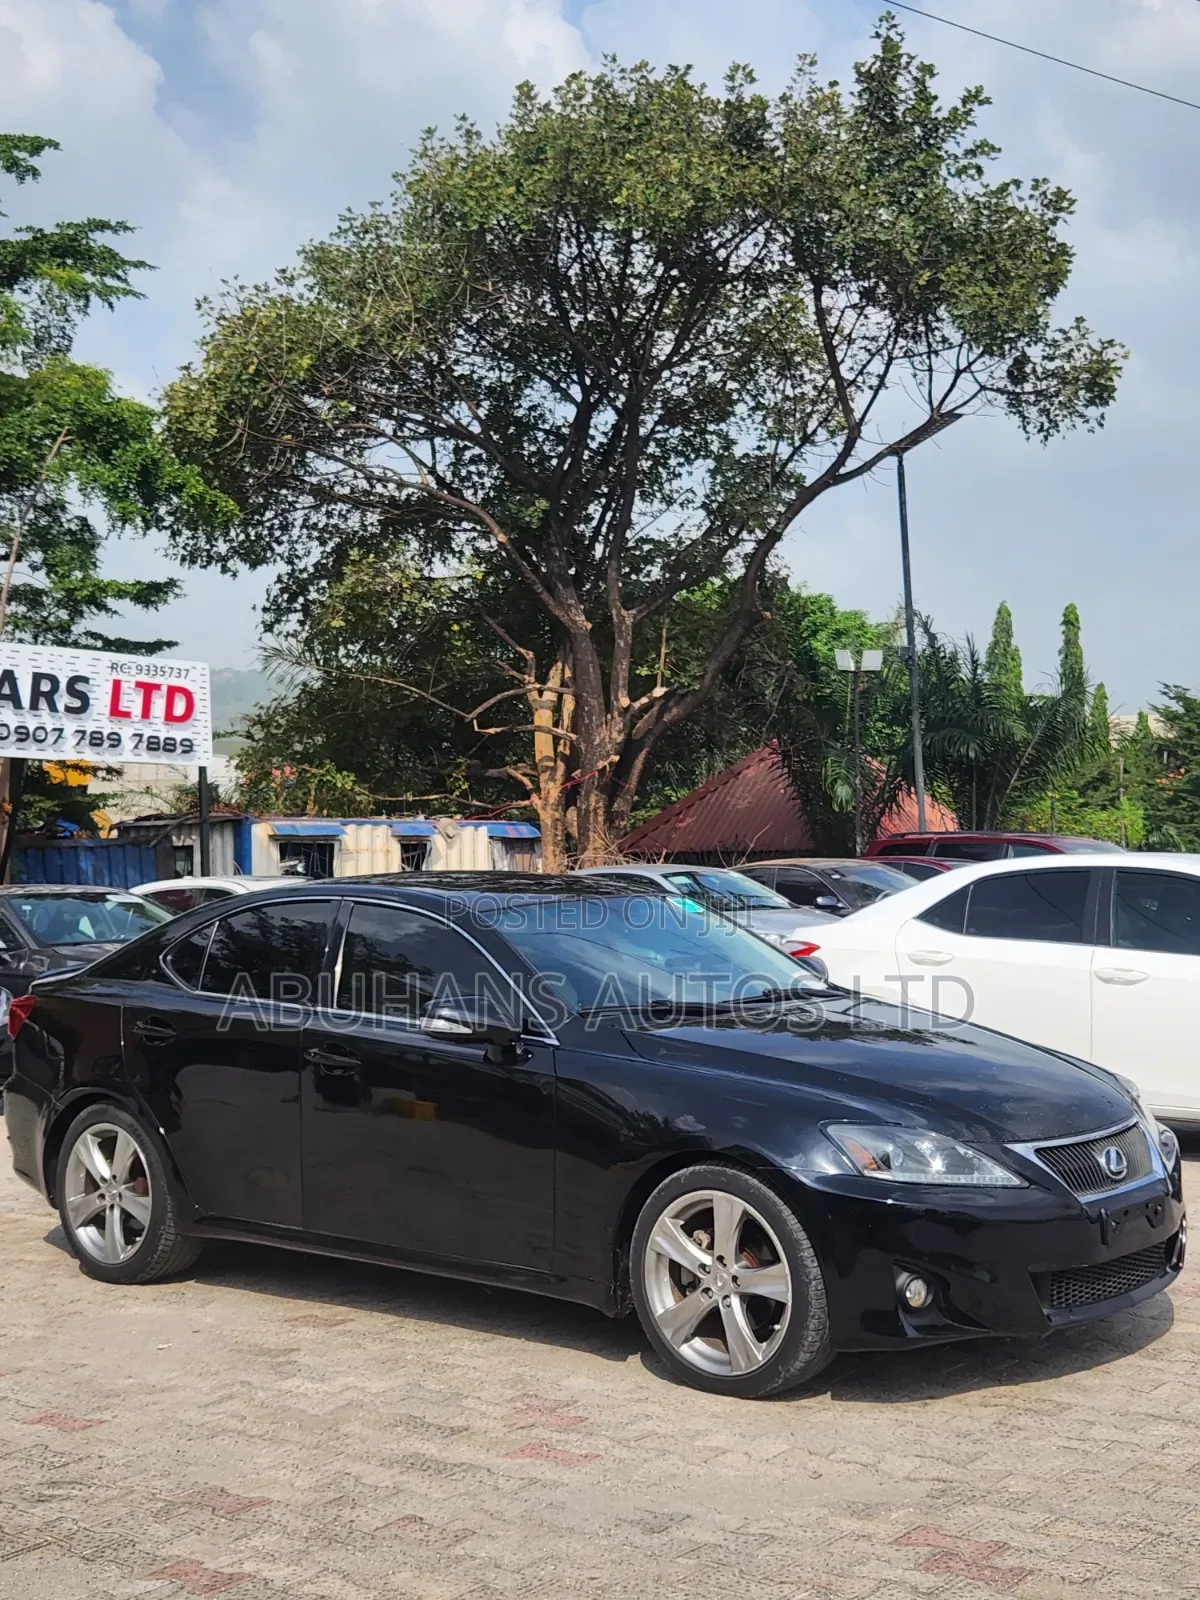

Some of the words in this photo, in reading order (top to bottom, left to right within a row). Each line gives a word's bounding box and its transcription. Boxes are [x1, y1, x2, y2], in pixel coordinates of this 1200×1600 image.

[108, 678, 196, 724] LTD
[72, 729, 122, 749] 789
[130, 732, 195, 755] 7889
